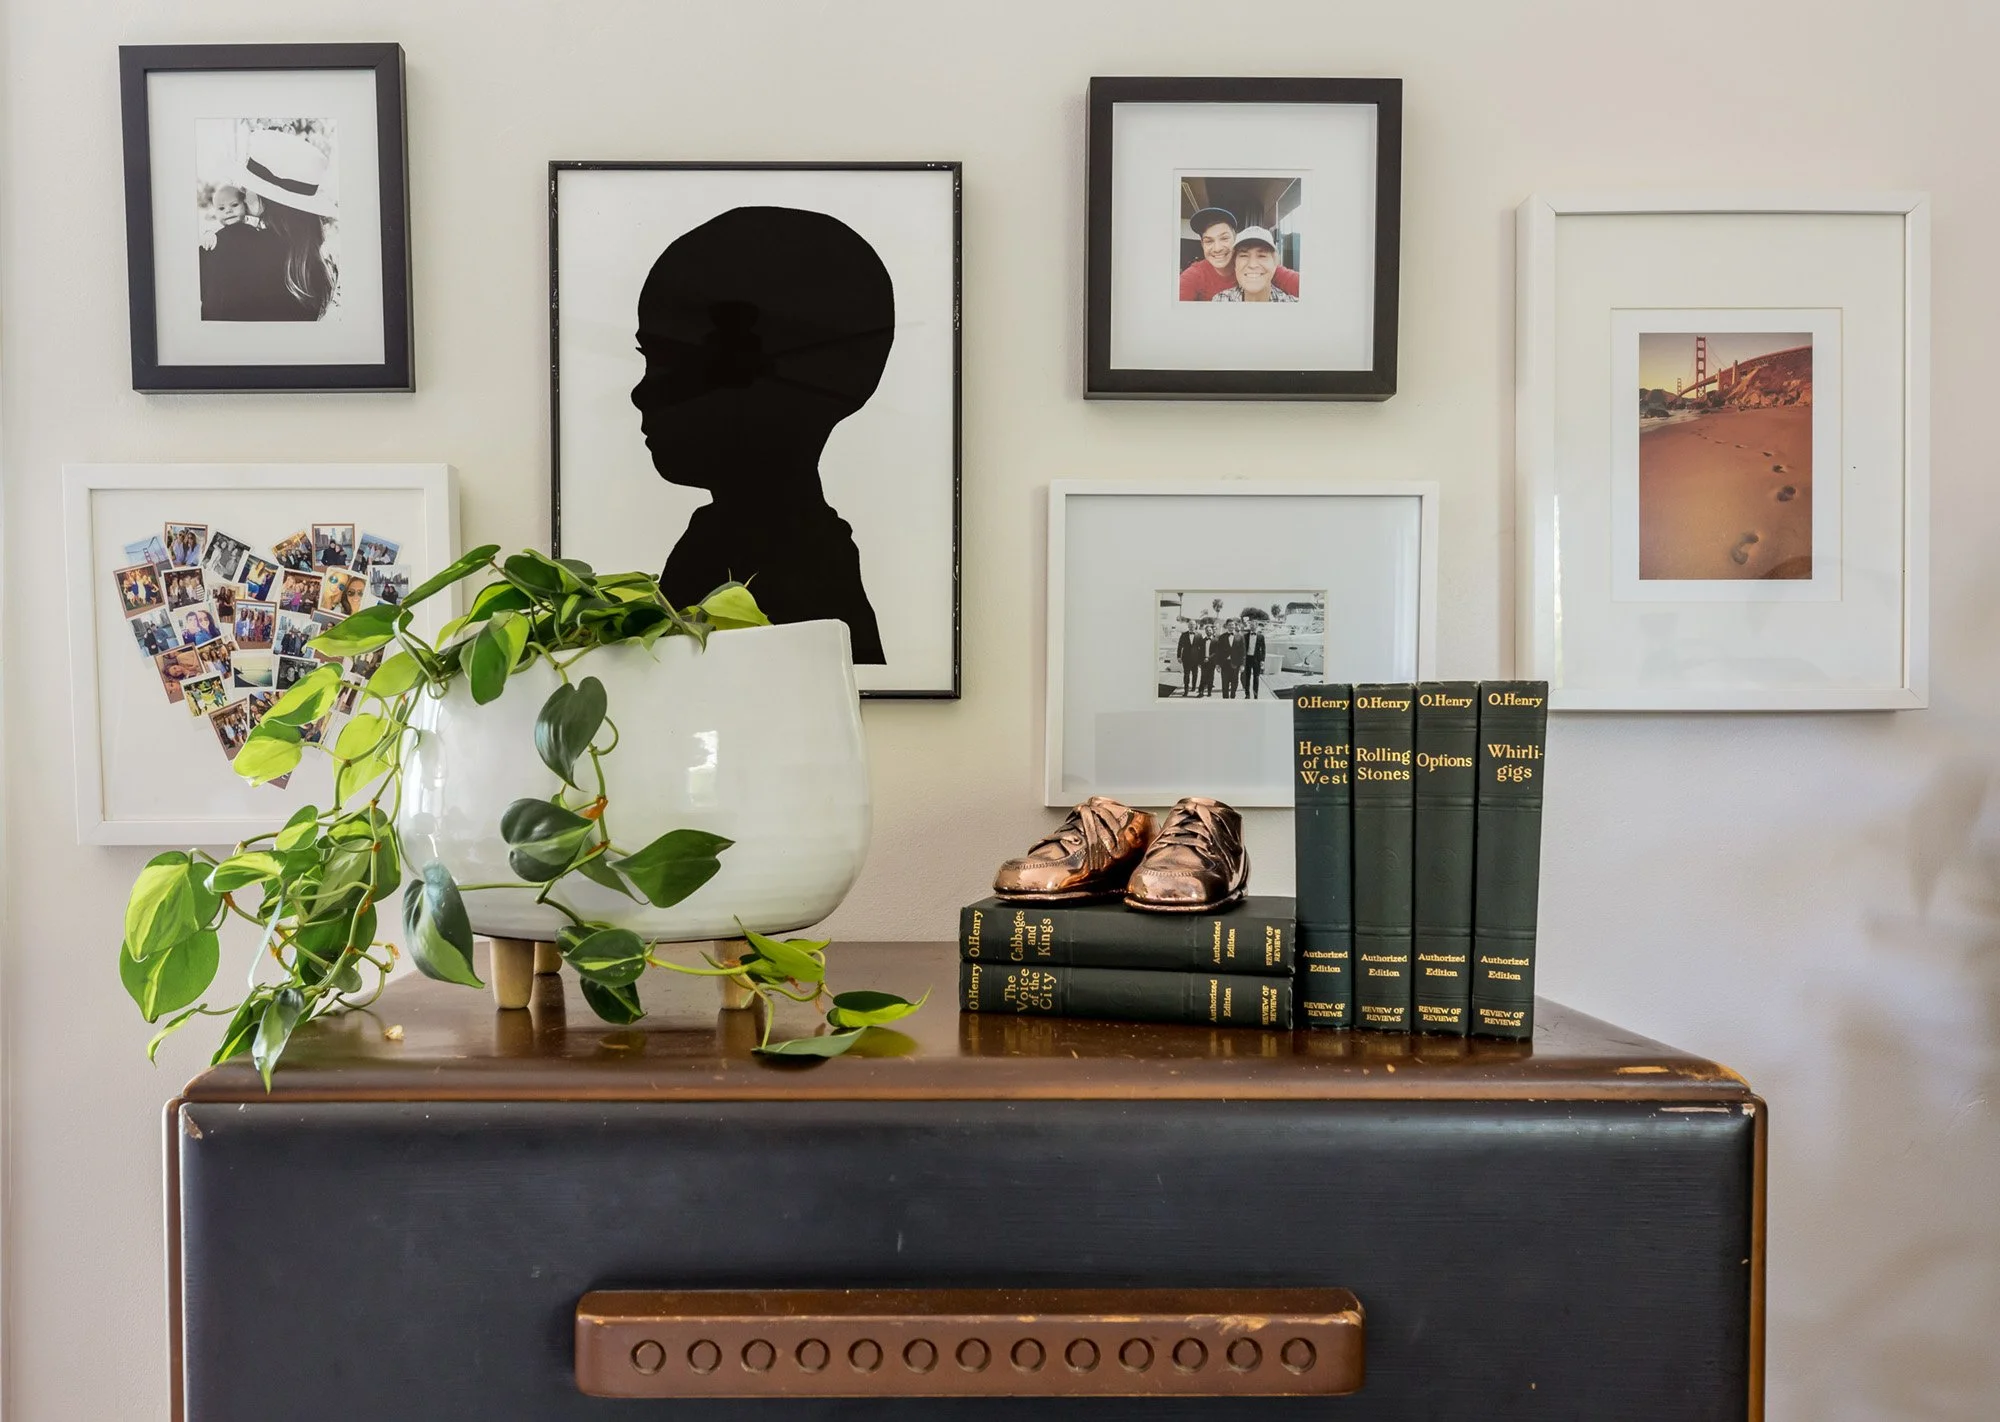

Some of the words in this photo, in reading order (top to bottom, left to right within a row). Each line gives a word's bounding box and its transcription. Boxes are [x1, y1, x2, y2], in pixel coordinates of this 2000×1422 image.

[1299, 741, 1349, 755] Heart
[1488, 744, 1543, 759] Whirli-
[1357, 748, 1411, 764] Rolling
[1303, 757, 1319, 768] of
[1324, 757, 1348, 768] the
[1417, 753, 1472, 772] Options
[1301, 771, 1348, 784] West
[1357, 767, 1410, 780] Stones
[1497, 765, 1532, 782] gigs
[1010, 911, 1025, 961] Cabbages
[1025, 925, 1036, 945] and
[1267, 926, 1273, 935] OF
[1038, 918, 1053, 956] Kings
[1213, 921, 1221, 964] Authorized
[1227, 929, 1235, 958] Edition
[1303, 950, 1348, 959] Authorized
[1361, 954, 1407, 963] Authorized
[1418, 953, 1465, 963] Authorized
[1481, 955, 1529, 966] Authorized
[1310, 964, 1340, 973] Edition
[1369, 968, 1400, 977] Edition
[1426, 968, 1457, 977] Edition
[1029, 972, 1040, 990] the
[1488, 971, 1521, 981] Edition
[1005, 976, 1016, 1001] The
[1016, 968, 1030, 1012] Voice
[1040, 973, 1056, 1010] City
[1263, 985, 1269, 996] OF
[1030, 993, 1039, 1006] of
[1362, 1005, 1392, 1014] REVIEW
[1419, 1005, 1448, 1014] REVIEW
[1480, 1009, 1510, 1017] REVIEW
[1367, 1014, 1401, 1022] REVIEWS
[1423, 1014, 1458, 1023] REVIEWS
[1484, 1017, 1520, 1026] REVIEWS
